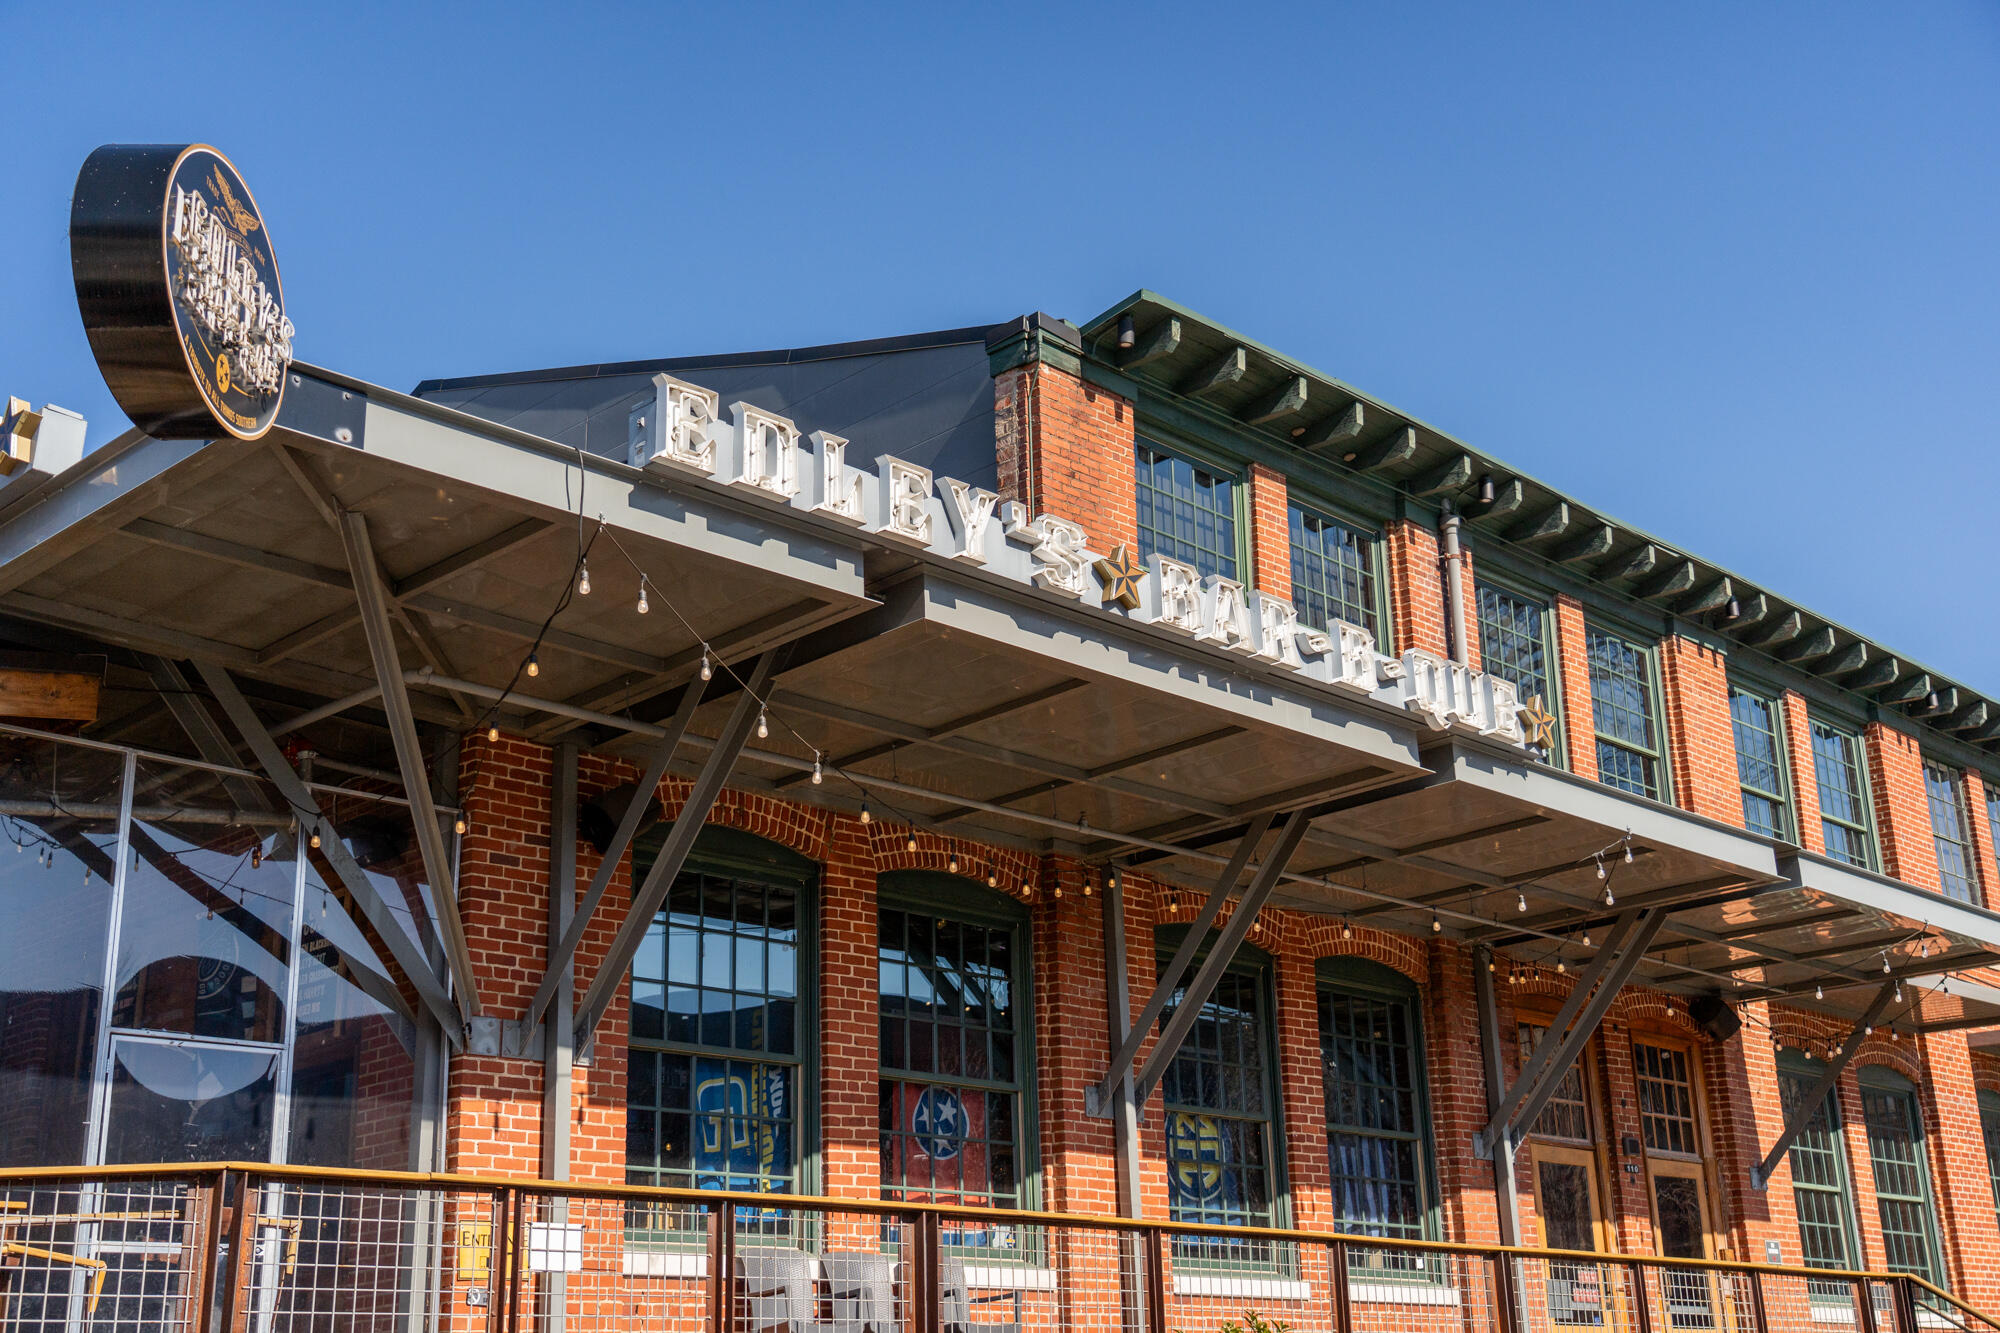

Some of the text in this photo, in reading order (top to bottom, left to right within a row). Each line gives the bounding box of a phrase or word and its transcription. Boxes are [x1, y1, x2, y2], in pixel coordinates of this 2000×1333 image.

[188, 342, 206, 385] TRIBUTE
[211, 389, 220, 409] ALL
[650, 372, 1522, 744] EDLEY'S BAR-B-QUE
[1627, 1165, 1639, 1173] 110
